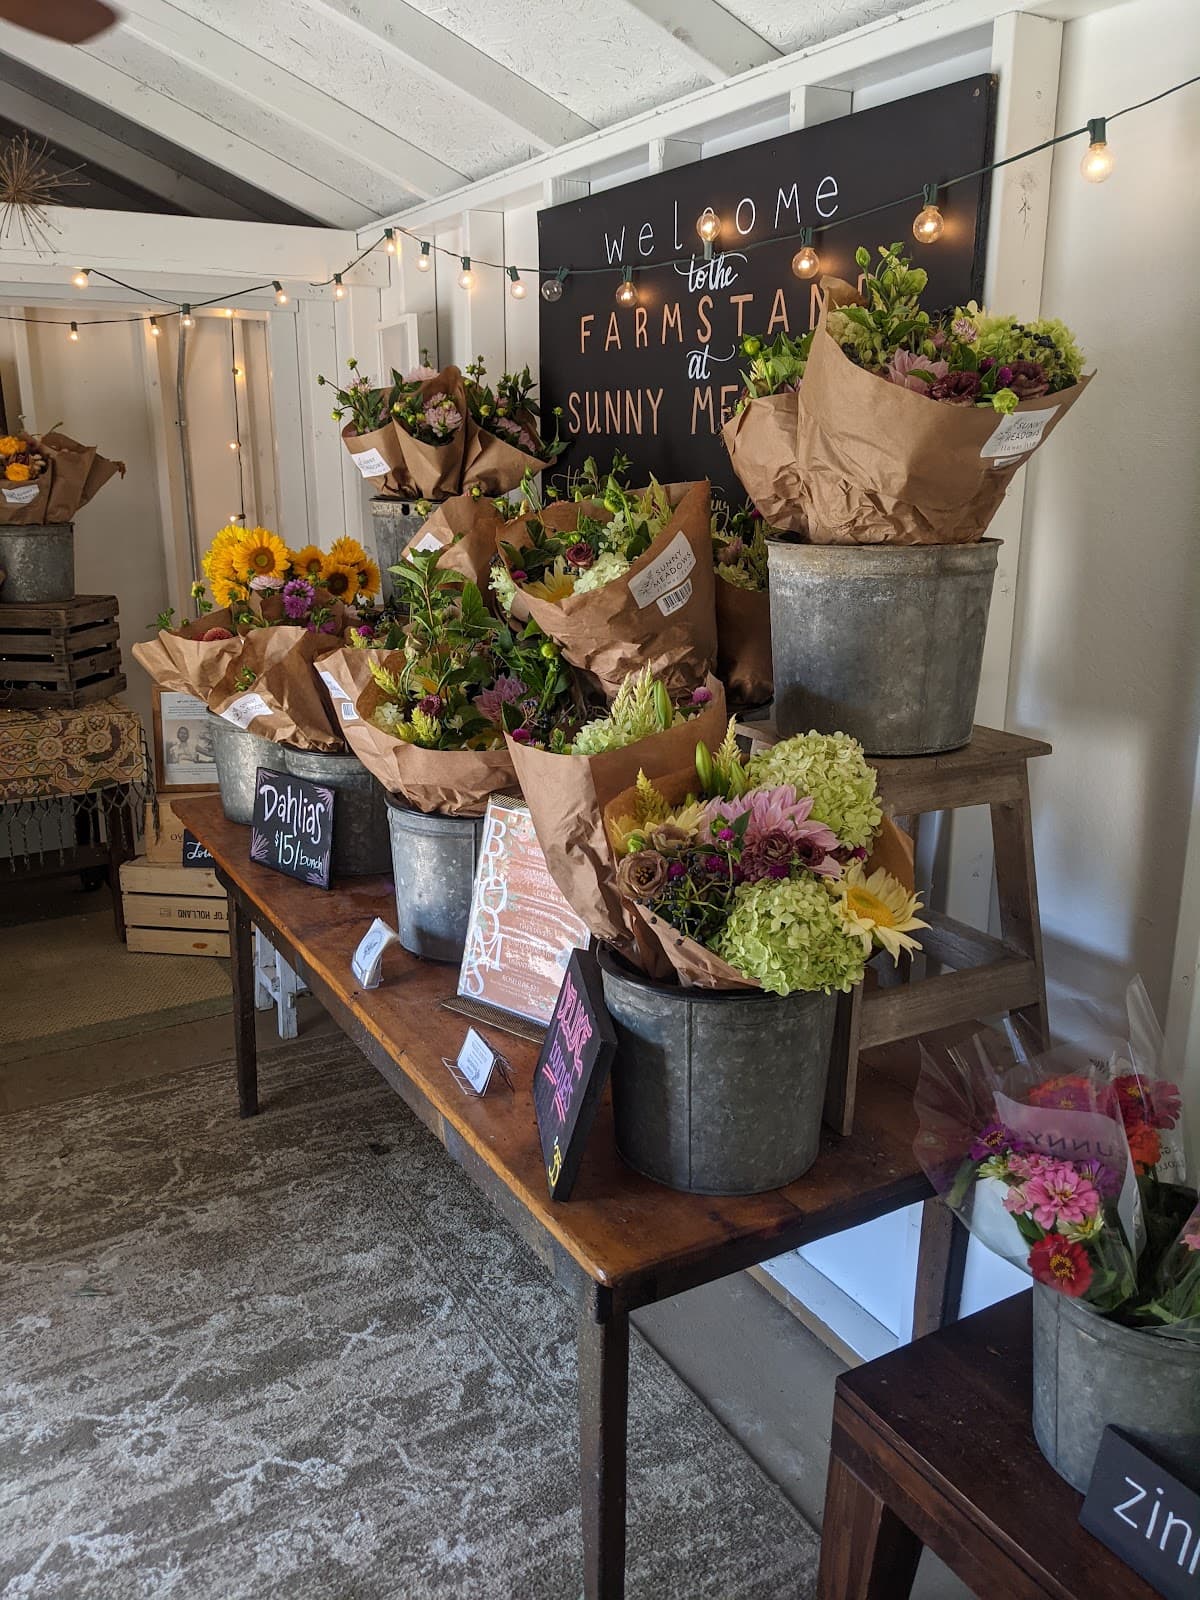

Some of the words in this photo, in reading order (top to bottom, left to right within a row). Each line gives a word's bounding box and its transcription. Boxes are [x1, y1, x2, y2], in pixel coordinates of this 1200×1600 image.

[686, 344, 736, 380] at
[568, 387, 664, 435] SUNNY
[653, 551, 692, 588] MEADOWS
[655, 548, 682, 575] SUNNY
[259, 784, 325, 845] Dahlias
[177, 909, 211, 920] HOLLAND
